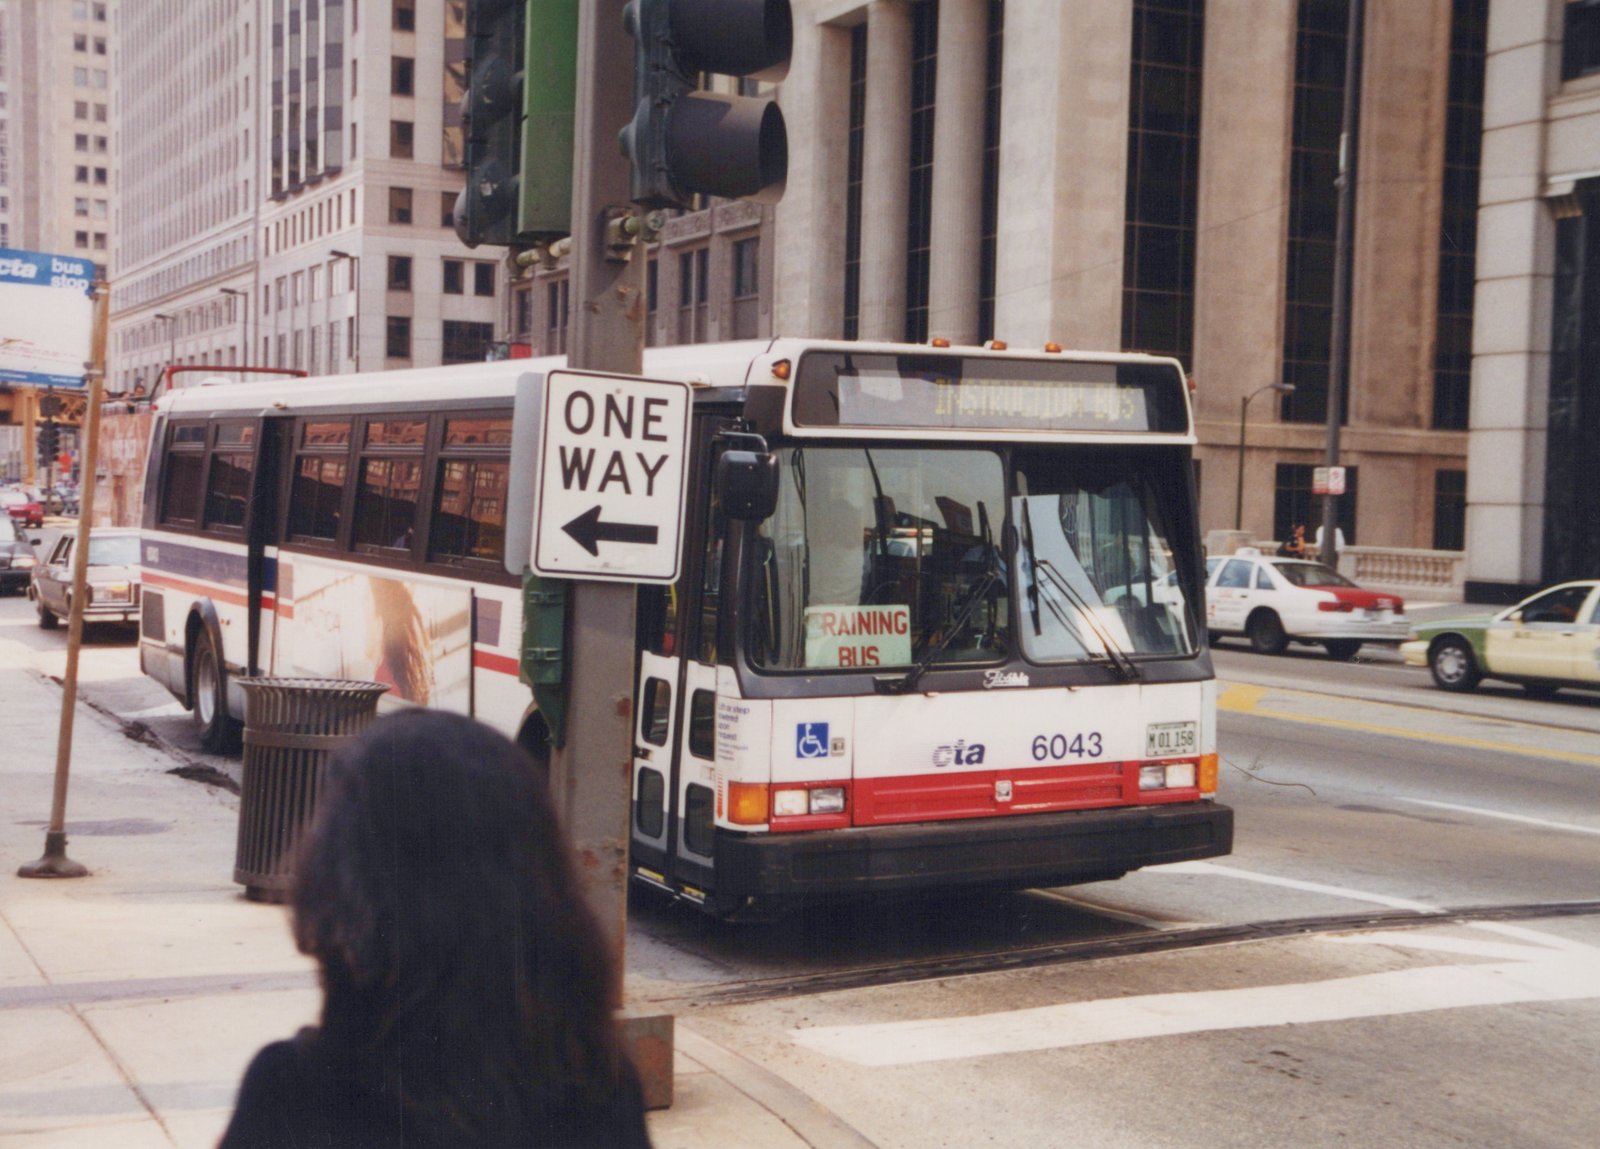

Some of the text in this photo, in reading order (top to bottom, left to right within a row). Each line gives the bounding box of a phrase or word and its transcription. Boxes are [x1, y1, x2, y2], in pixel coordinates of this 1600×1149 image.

[0, 257, 38, 279] cta
[51, 257, 84, 276] bus
[51, 273, 90, 291] stop
[564, 390, 669, 442] ONE
[559, 445, 669, 496] WAY
[811, 611, 908, 636] RAINING
[838, 646, 880, 668] BUS
[1031, 731, 1103, 761] 6043
